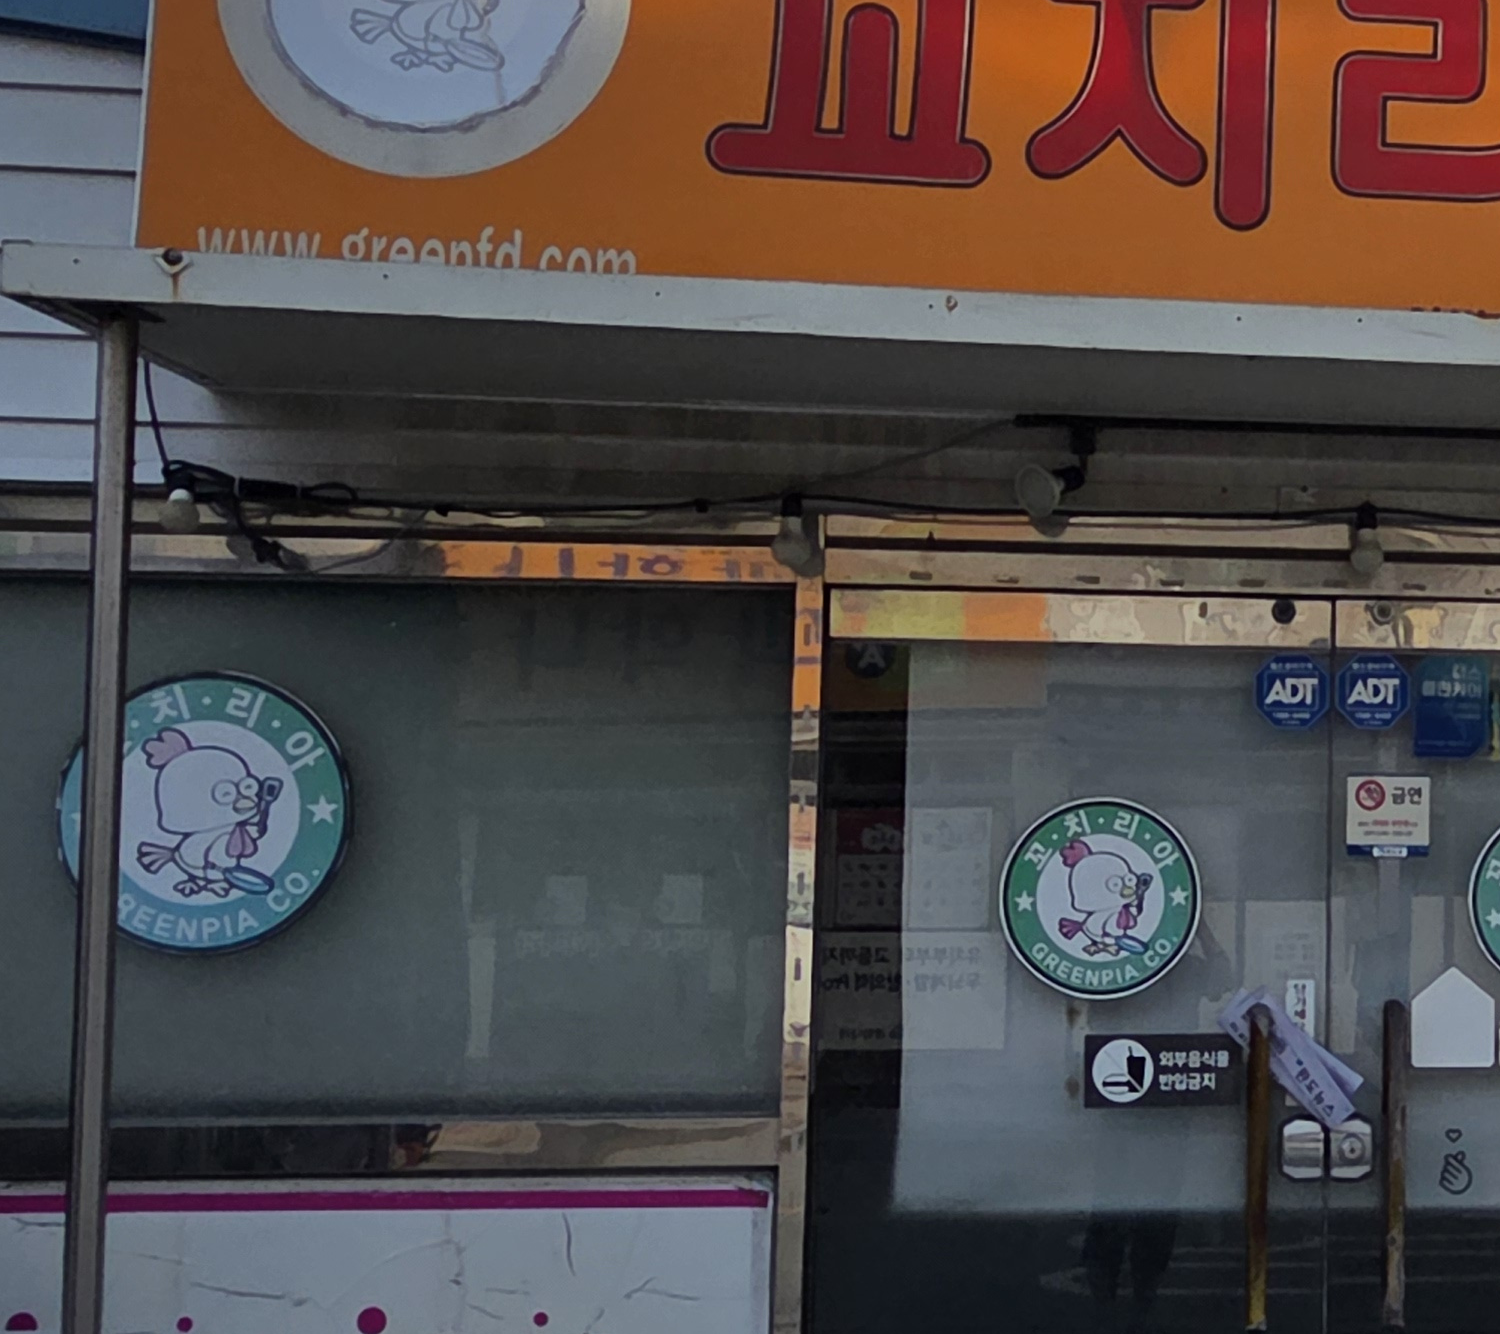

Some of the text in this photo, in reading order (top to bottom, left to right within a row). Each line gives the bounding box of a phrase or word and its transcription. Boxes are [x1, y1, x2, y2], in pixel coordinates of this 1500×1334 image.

[1264, 678, 1319, 705] ADT
[1347, 678, 1400, 705] ADT
[1391, 786, 1422, 806] 금연
[117, 893, 260, 943] REENPIA
[1031, 935, 1179, 988] GREENPIA CO.
[1158, 1050, 1230, 1068] 외부음식물
[1158, 1072, 1216, 1091] 반입금지
